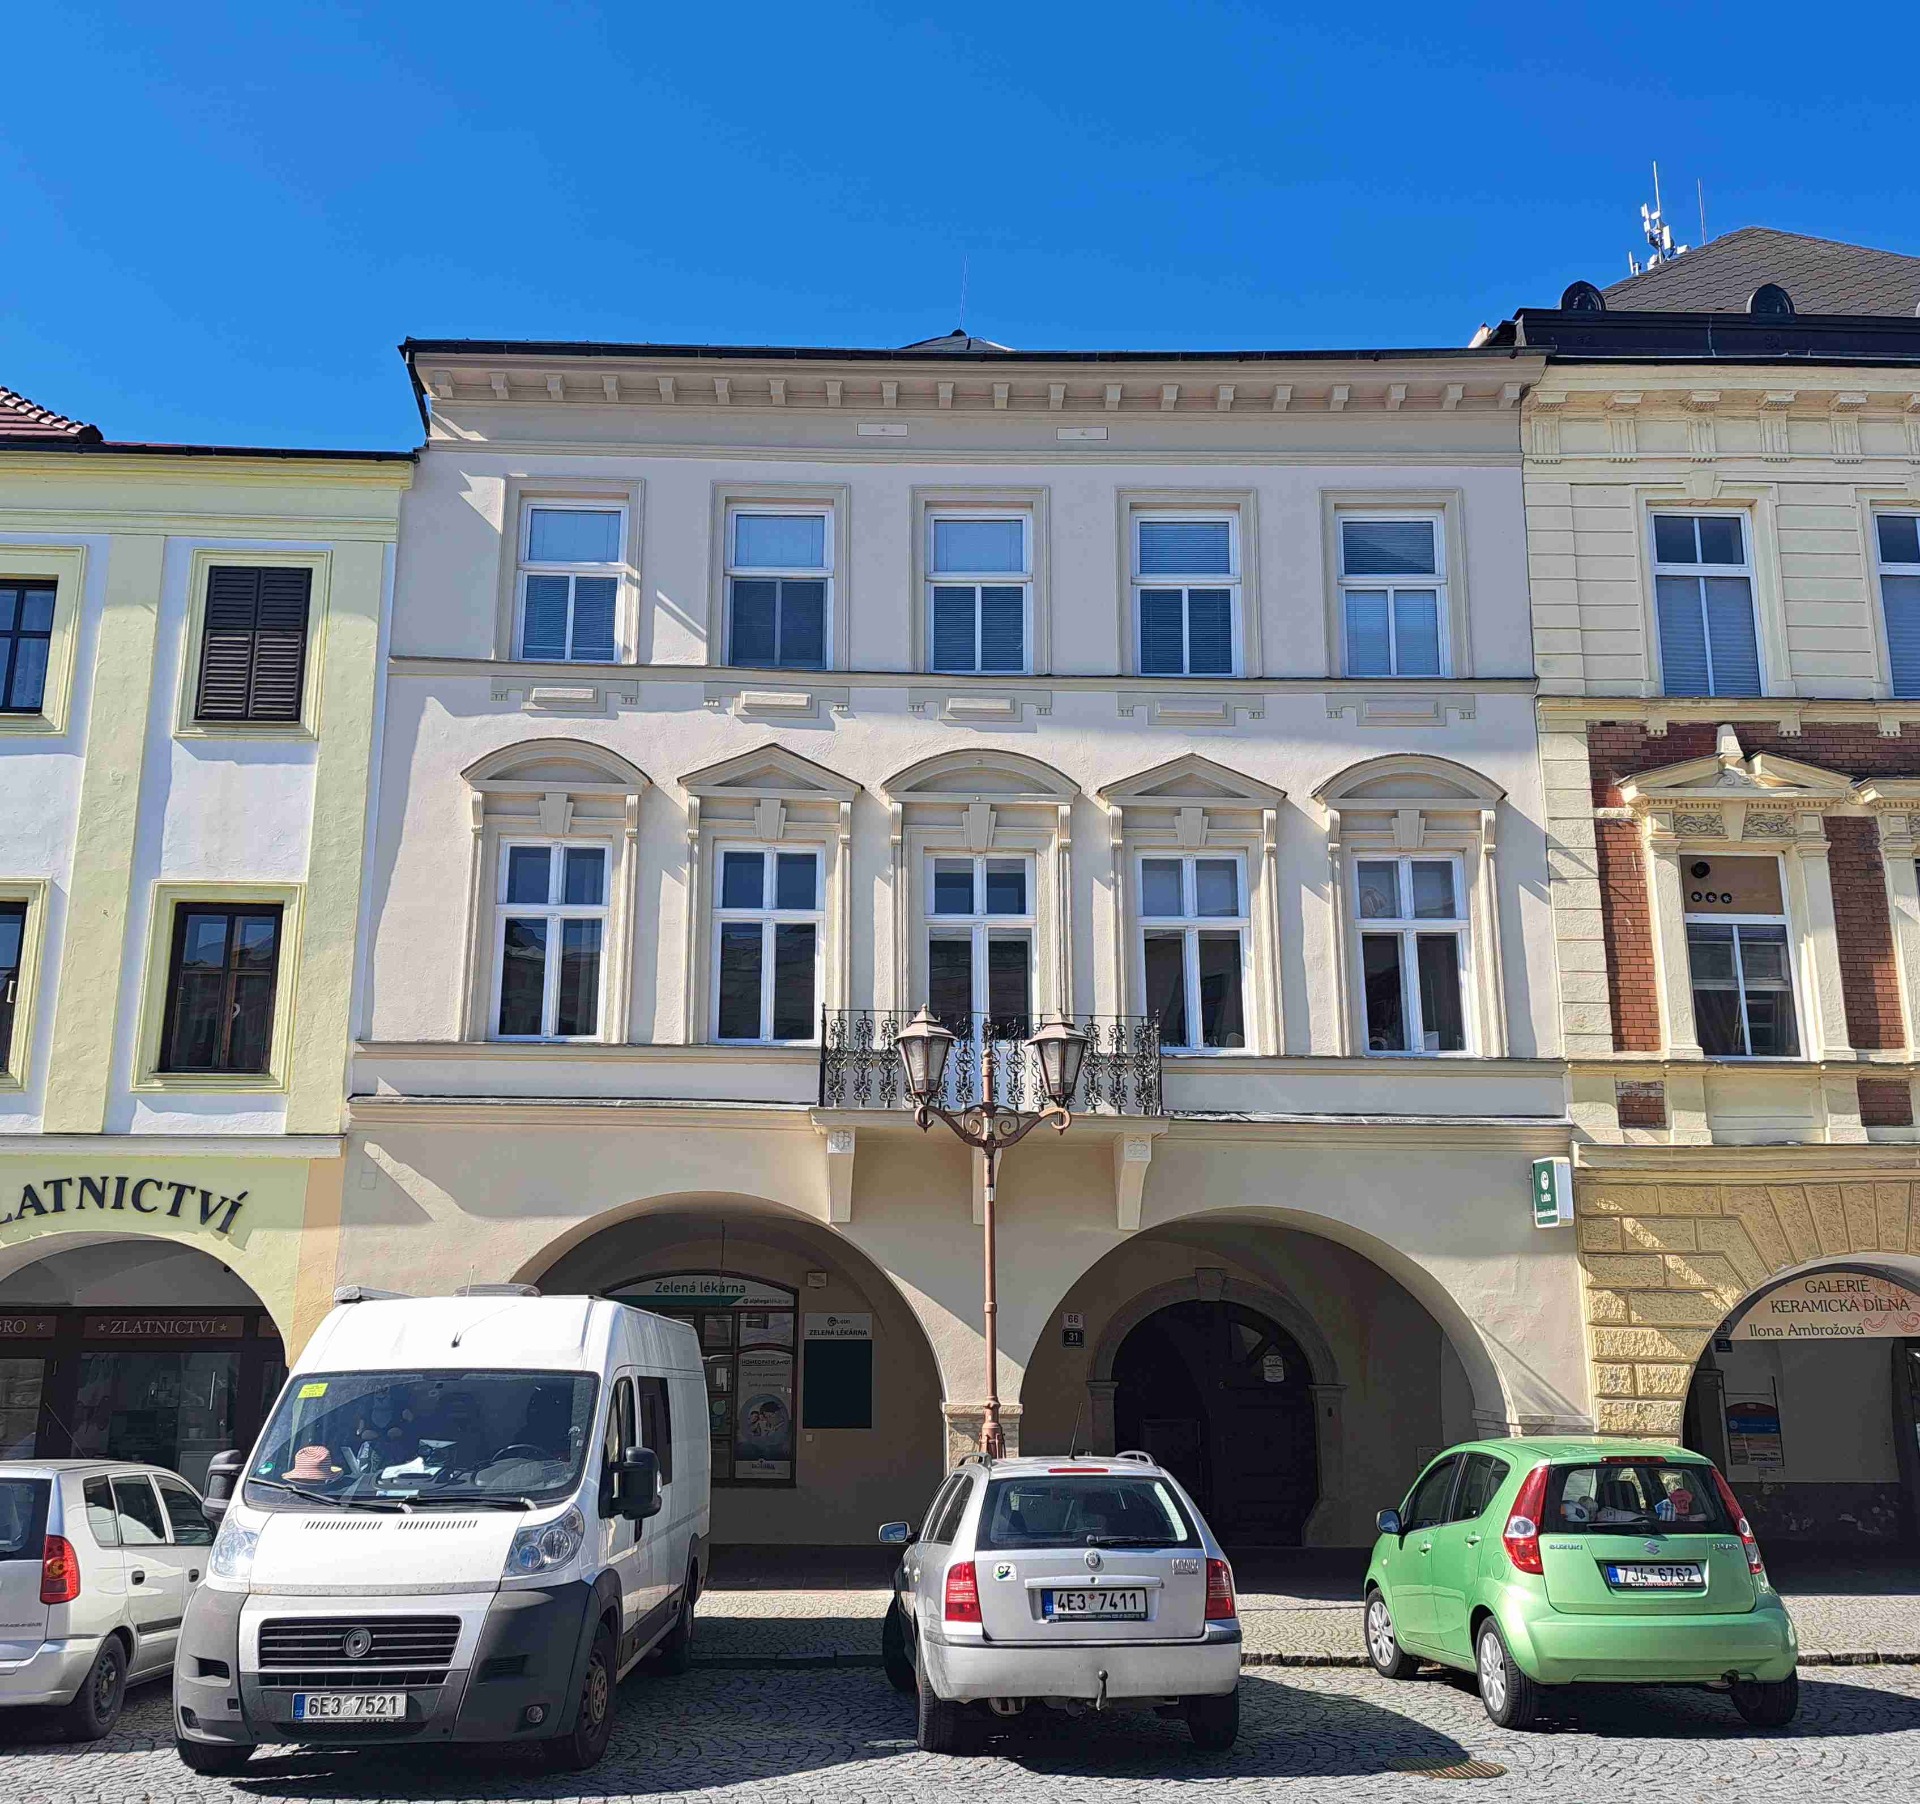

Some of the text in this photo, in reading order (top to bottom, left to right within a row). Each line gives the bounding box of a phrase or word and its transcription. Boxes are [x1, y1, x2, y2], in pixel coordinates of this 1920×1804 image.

[654, 1281, 746, 1294] Zelená lékárna
[1805, 1279, 1871, 1293] GALERIE
[1770, 1295, 1911, 1313] KERAMICKÁ DÍLNA
[110, 1316, 217, 1335] ZLATNICTVÍ
[1067, 1314, 1079, 1323] 66
[809, 1327, 868, 1336] ZELENÁ LÉKÁRNA
[1068, 1332, 1079, 1341] 31
[1749, 1322, 1865, 1337] Ilona Ambrožová
[997, 1565, 1011, 1574] CZ
[1620, 1567, 1648, 1582] 7J4
[1657, 1567, 1695, 1582] 6762
[1057, 1593, 1086, 1611] 4E3
[1098, 1592, 1137, 1610] 7411
[308, 1697, 341, 1716] 6E3
[355, 1695, 397, 1715] 7521
